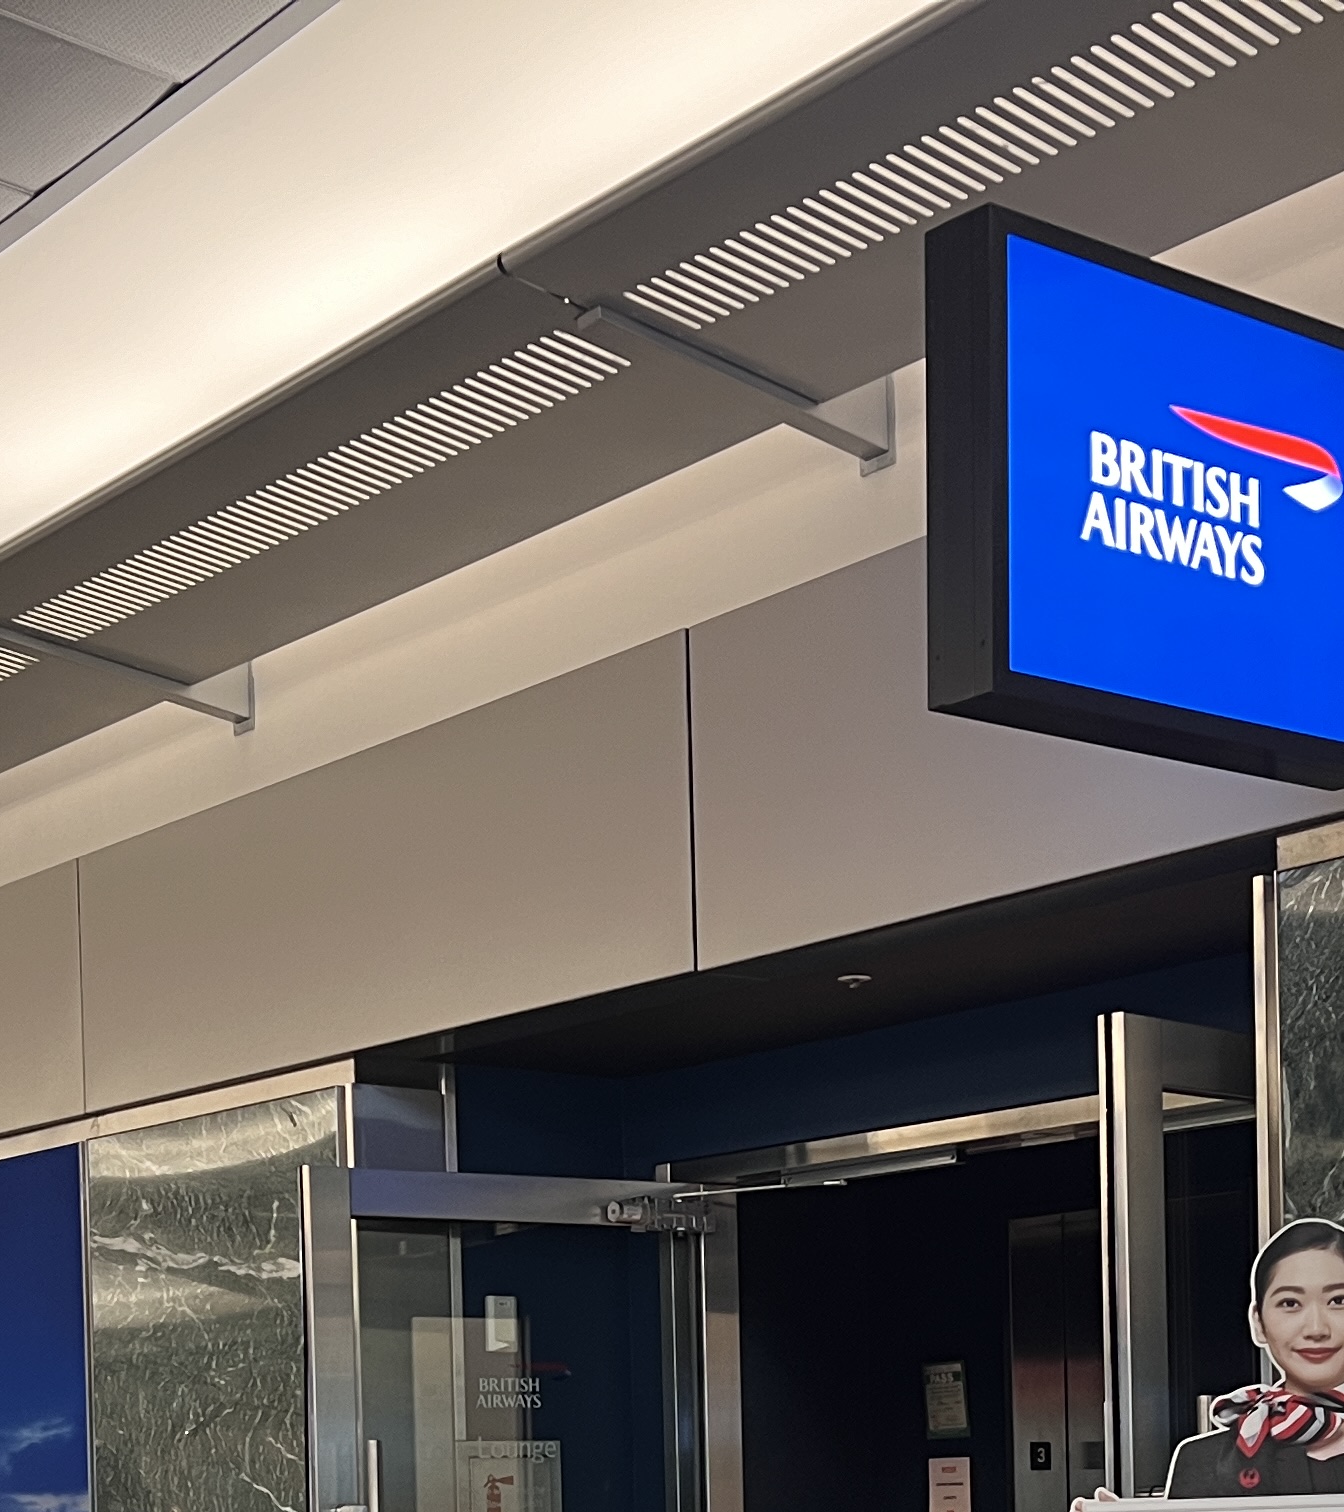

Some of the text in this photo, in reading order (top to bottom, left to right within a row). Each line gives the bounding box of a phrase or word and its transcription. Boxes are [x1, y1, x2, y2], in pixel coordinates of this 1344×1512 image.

[1090, 430, 1260, 528] BRITISH
[1080, 491, 1265, 586] AIRWAYS
[479, 1377, 540, 1392] BRITISH
[475, 1393, 542, 1409] AIRWAYS
[478, 1435, 557, 1463] Lounge
[1037, 1447, 1046, 1463] 3
